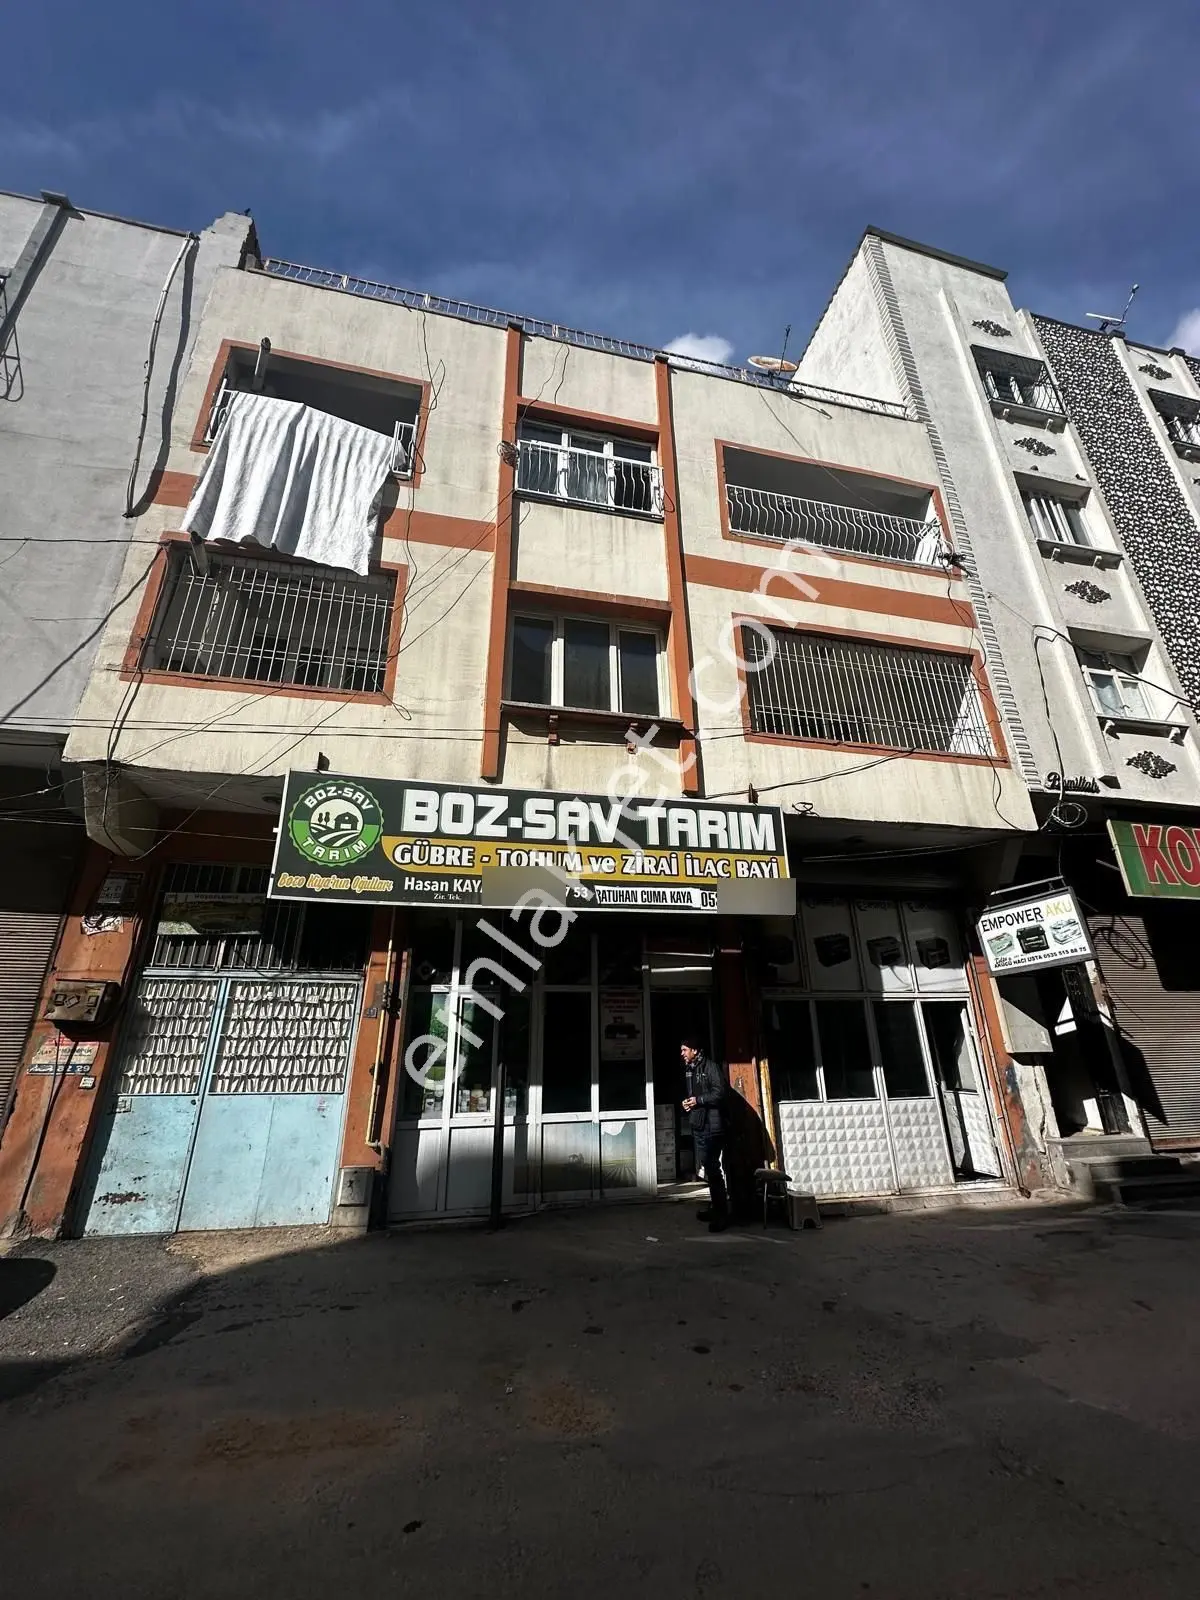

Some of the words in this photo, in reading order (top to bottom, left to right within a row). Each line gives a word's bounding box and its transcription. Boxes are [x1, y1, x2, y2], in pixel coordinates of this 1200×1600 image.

[304, 786, 374, 810] BOZ-SAV
[402, 789, 622, 843] BOZ-SAV
[637, 805, 777, 851] TARIM
[302, 836, 368, 860] TARIM
[394, 840, 475, 867] GÜBRE
[497, 849, 582, 873] TOHUM
[588, 856, 616, 874] ve
[1131, 824, 1200, 887] KO
[404, 877, 449, 892] Hasan
[453, 878, 482, 893] KAY
[641, 891, 664, 903] CUMA
[670, 891, 693, 904] KAYA
[701, 892, 717, 908] 05
[981, 907, 1044, 932] EMPOWER
